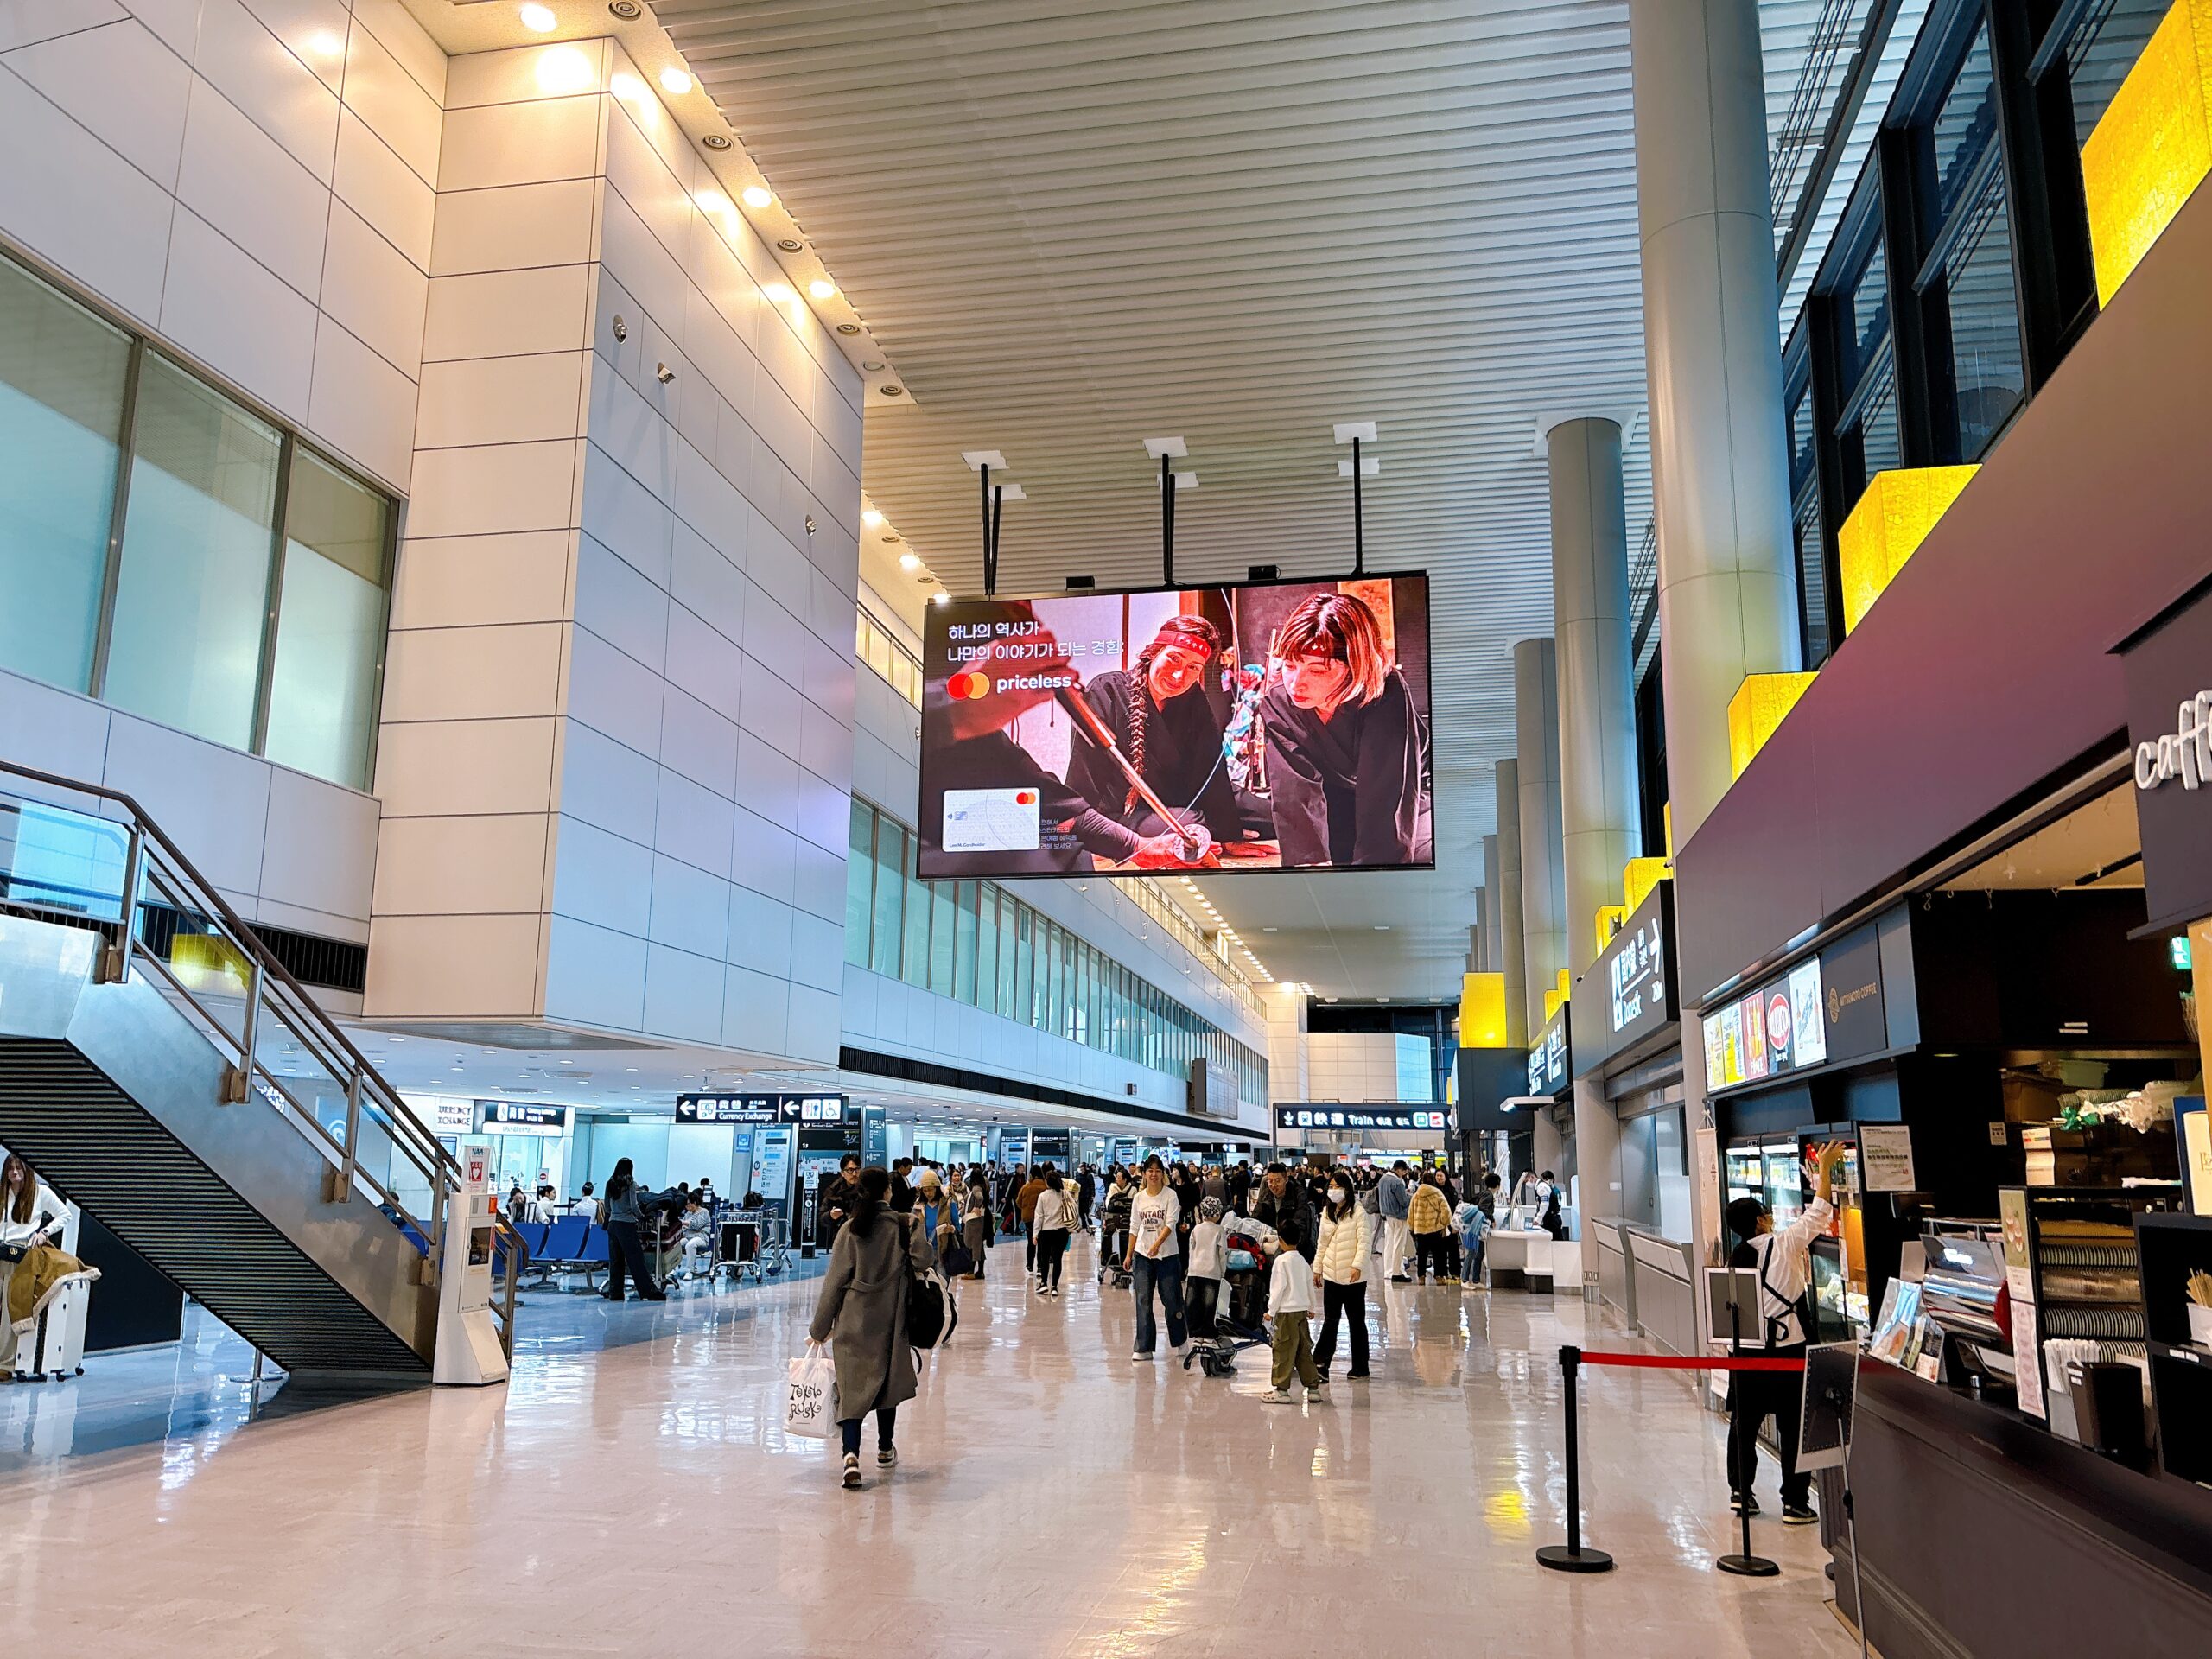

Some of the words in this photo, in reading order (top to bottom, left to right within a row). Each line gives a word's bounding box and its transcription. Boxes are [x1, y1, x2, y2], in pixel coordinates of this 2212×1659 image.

[948, 623, 991, 639] 하나의
[995, 620, 1039, 637] 역사가
[947, 645, 991, 662] 나만의
[995, 643, 1053, 659] 이야기가
[1057, 641, 1087, 657] 되는
[996, 674, 1071, 694] priceless
[2134, 690, 2212, 791] caff
[1039, 825, 1070, 834] 스터카드의
[718, 1112, 744, 1122] Currency
[744, 1112, 773, 1122] Exchange
[1348, 1114, 1374, 1127] Train
[789, 1382, 823, 1403] TOKYO
[789, 1401, 823, 1421] RUSK
